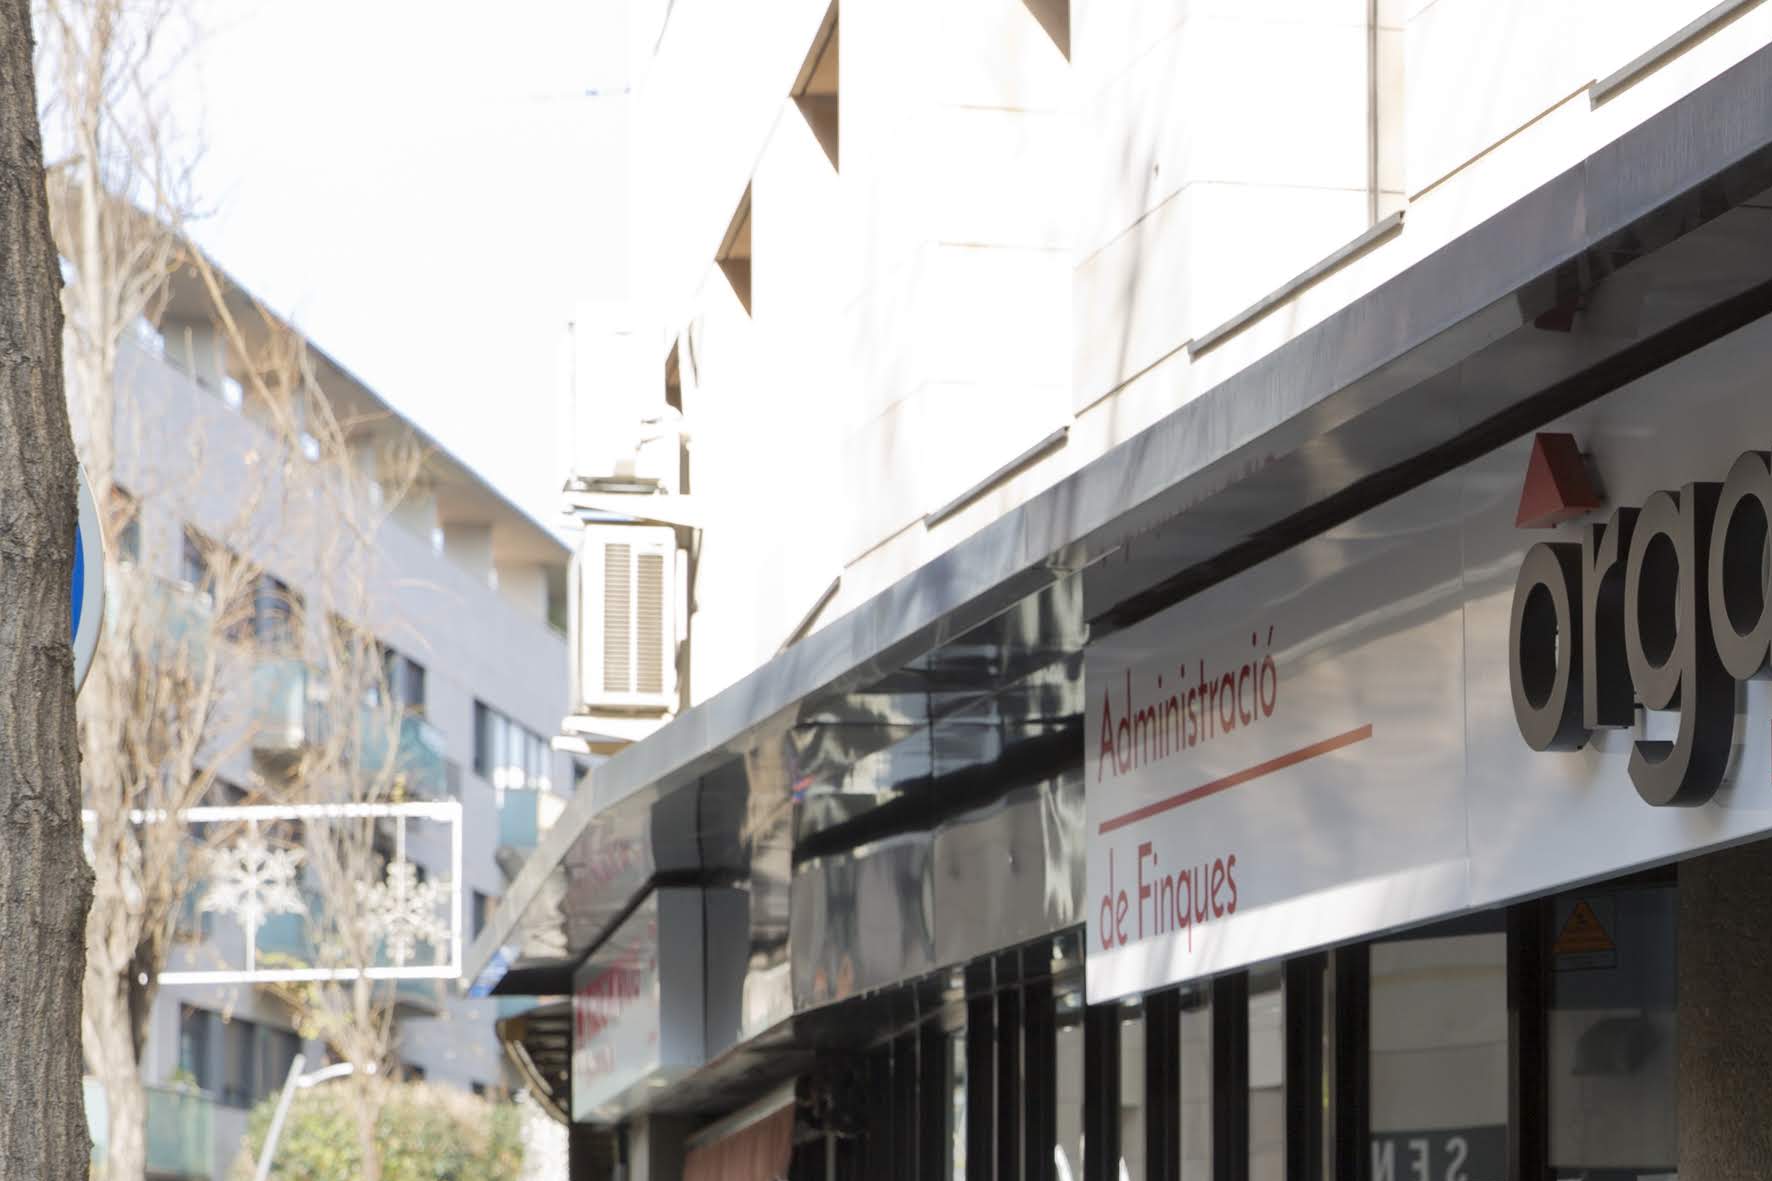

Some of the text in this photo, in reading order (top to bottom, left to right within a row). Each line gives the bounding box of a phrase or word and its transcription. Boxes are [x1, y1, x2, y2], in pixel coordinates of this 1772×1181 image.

[1098, 624, 1277, 783] Administració
[1100, 841, 1238, 953] de Finques
